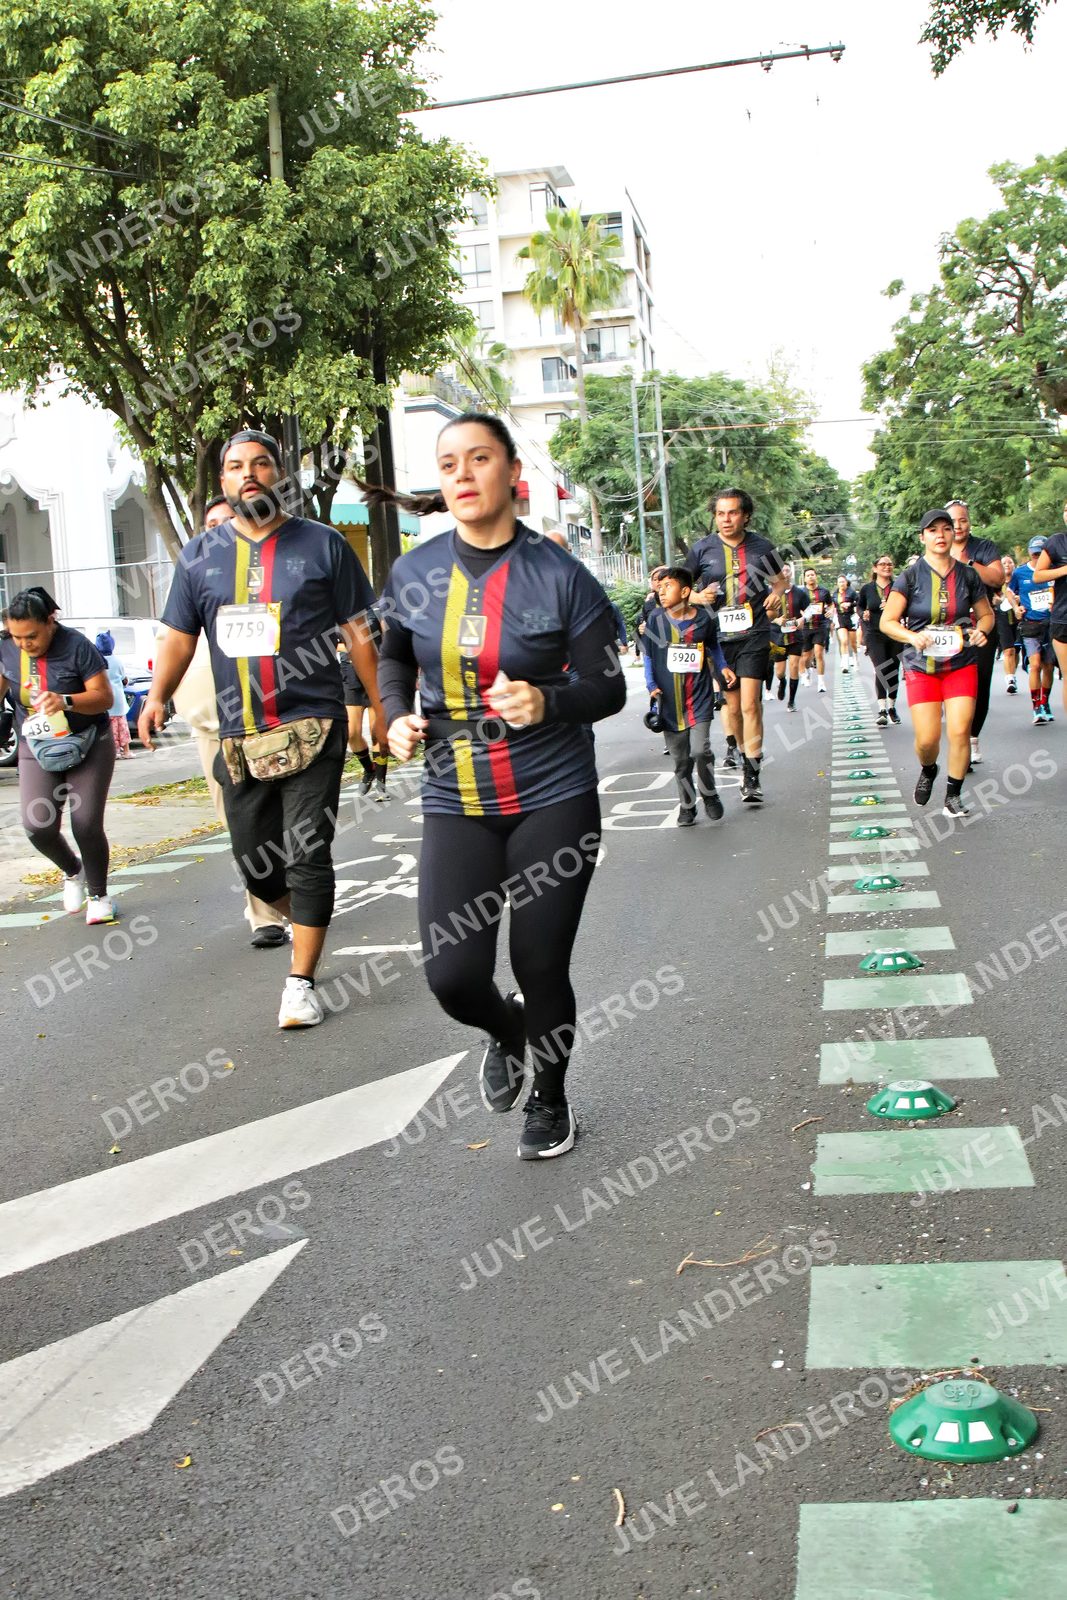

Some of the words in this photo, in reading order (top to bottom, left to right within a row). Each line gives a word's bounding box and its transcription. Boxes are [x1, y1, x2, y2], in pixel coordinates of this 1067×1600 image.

[723, 612, 746, 624] 7748
[225, 620, 265, 639] 7759
[935, 635, 953, 646] 051
[672, 652, 696, 663] 5920
